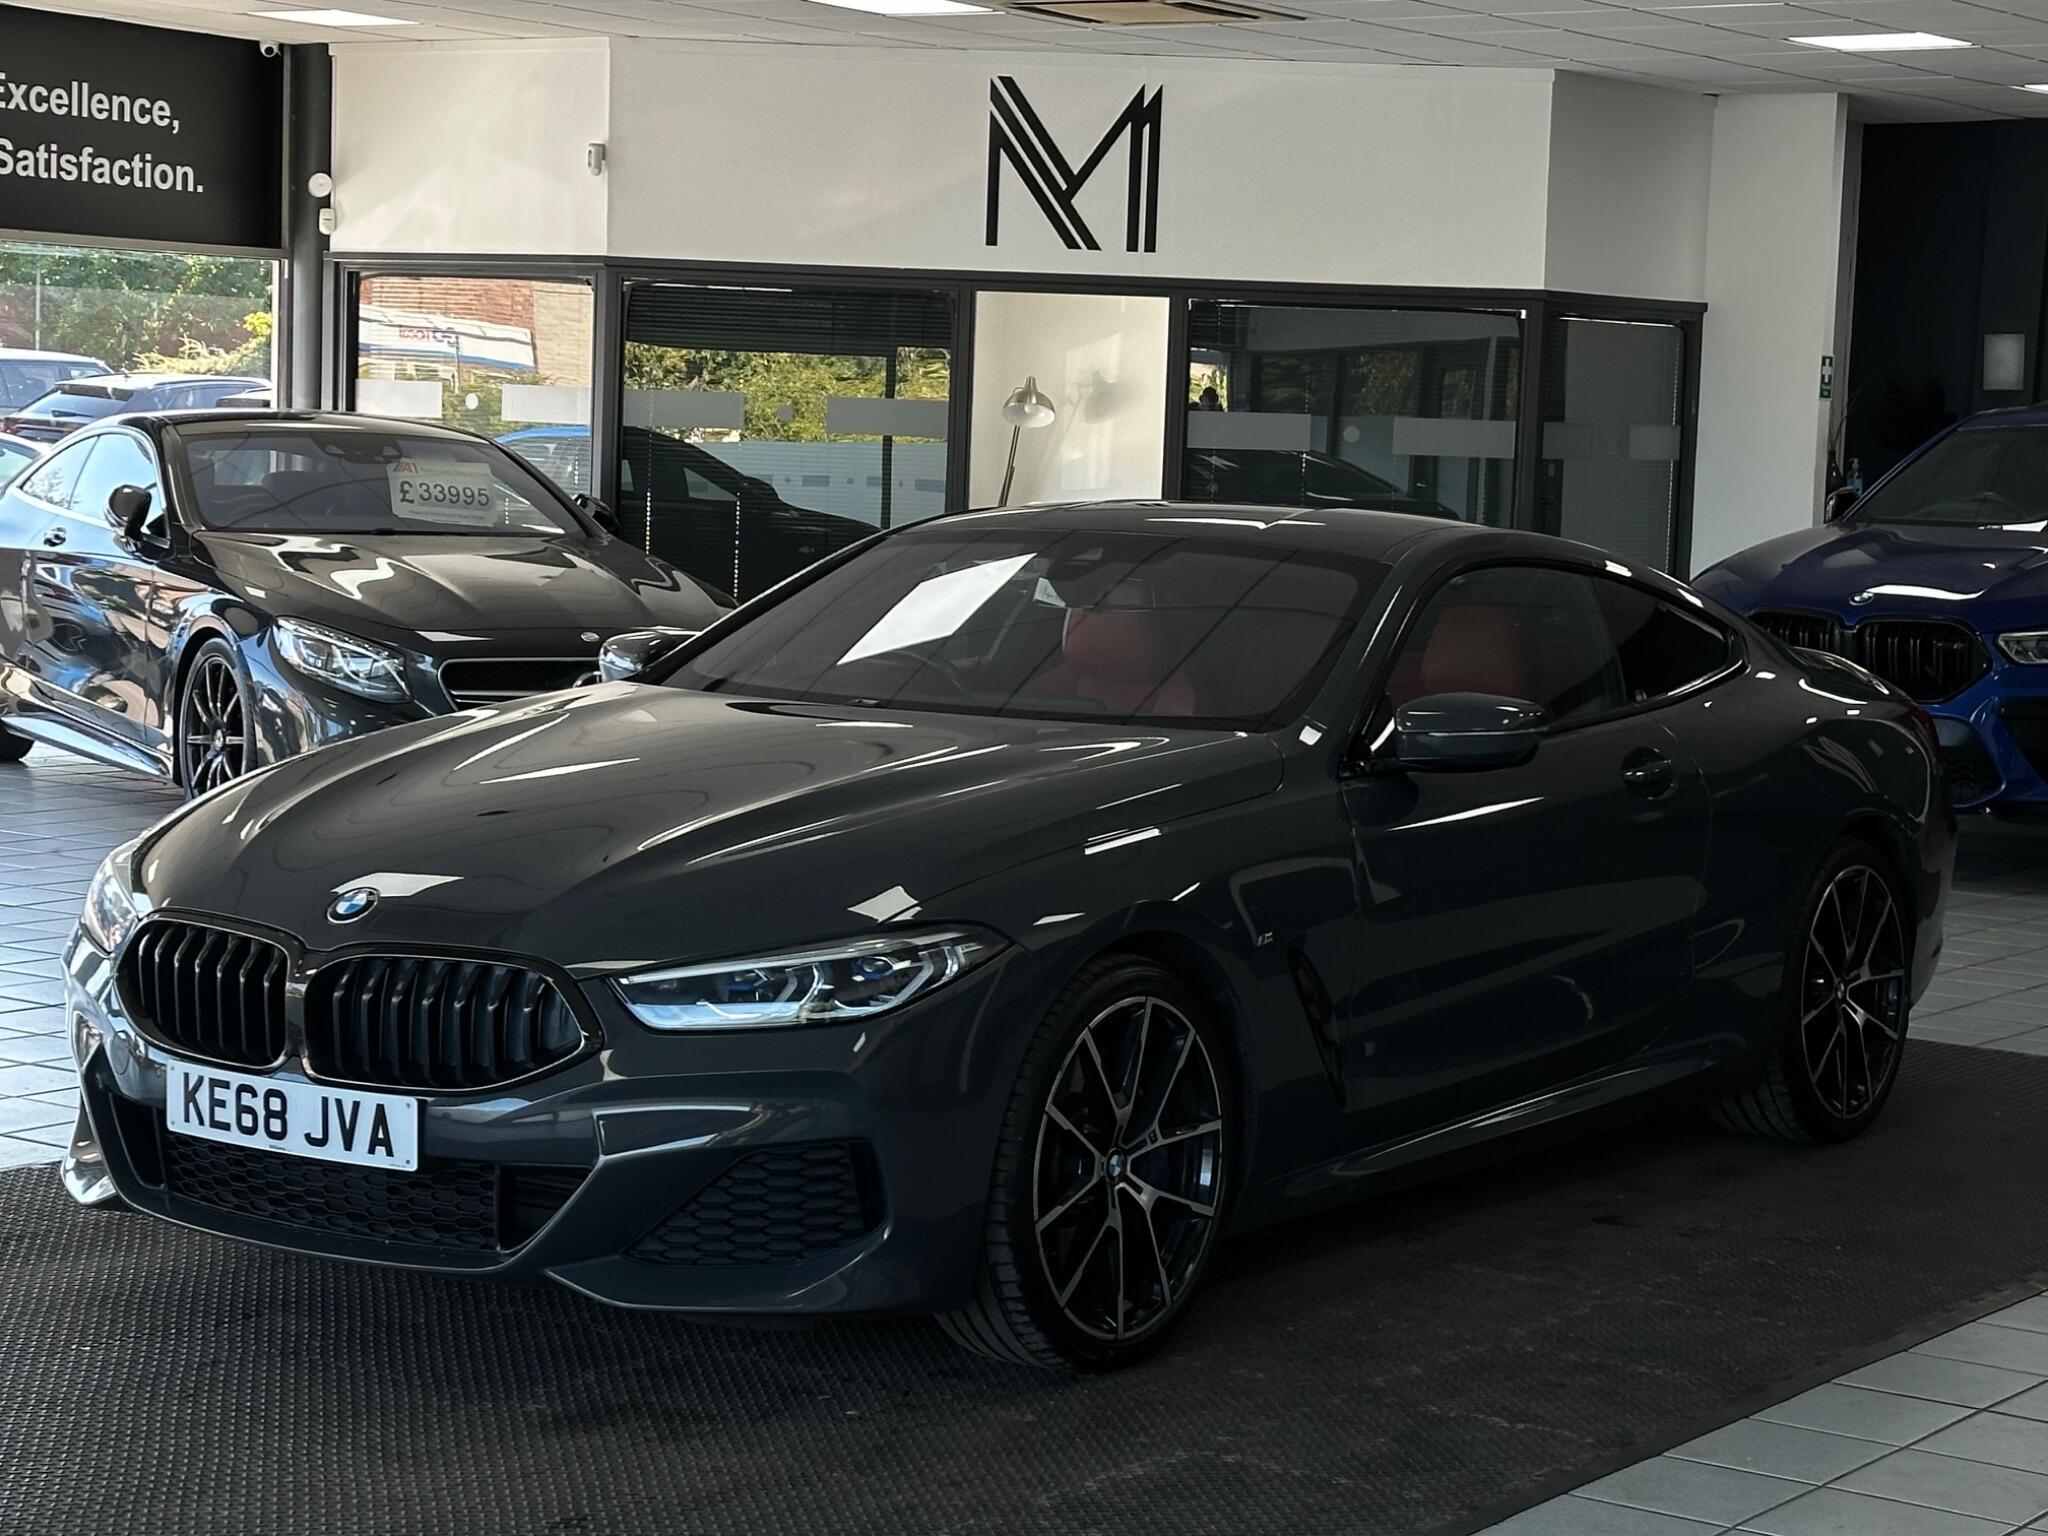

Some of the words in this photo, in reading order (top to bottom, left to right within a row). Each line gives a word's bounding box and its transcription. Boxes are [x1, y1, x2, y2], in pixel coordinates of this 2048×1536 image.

[0, 72, 180, 134] xcellence,
[400, 481, 490, 506] £33995
[183, 1071, 288, 1141] KE68
[304, 1096, 394, 1158] JVA
